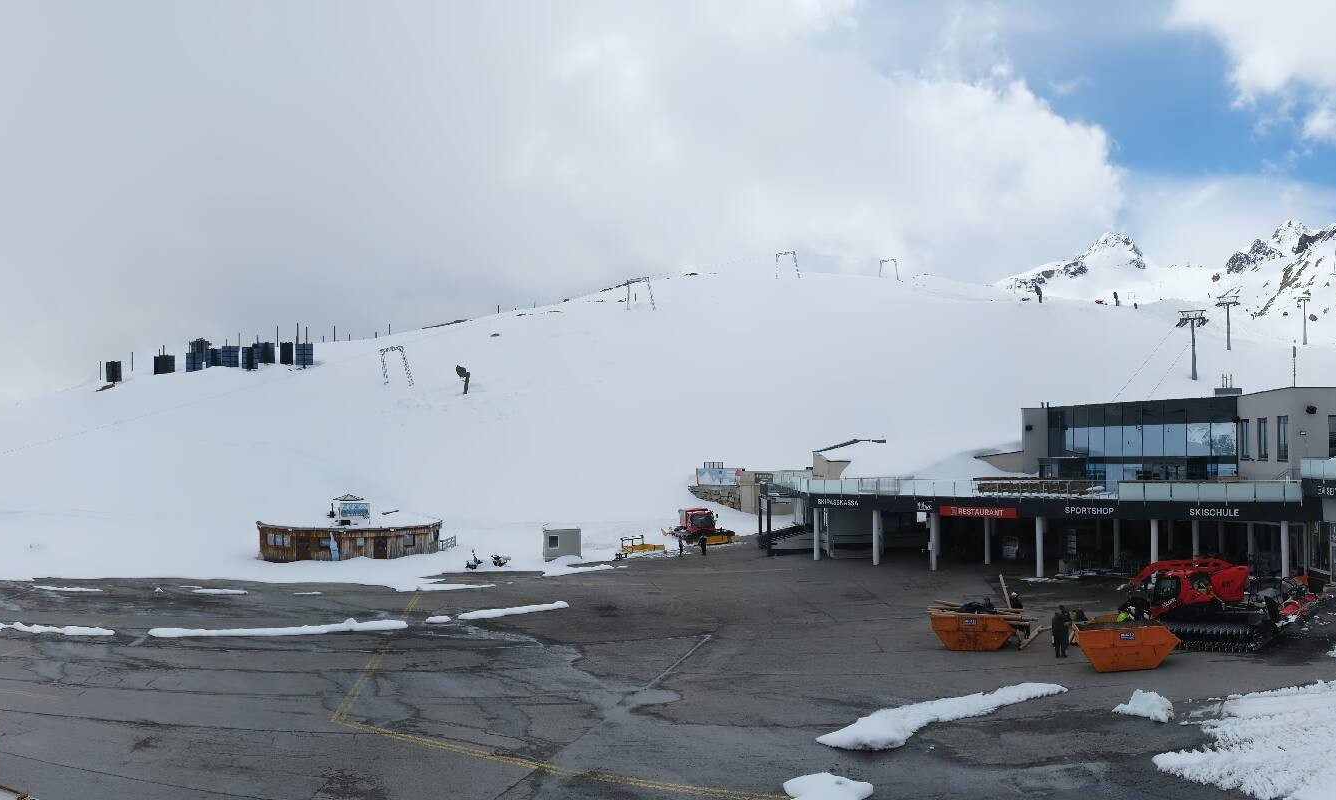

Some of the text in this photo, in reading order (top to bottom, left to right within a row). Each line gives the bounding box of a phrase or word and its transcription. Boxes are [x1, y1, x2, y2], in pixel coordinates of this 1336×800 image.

[817, 498, 859, 506] SKIPASSKASSA
[958, 507, 1004, 517] RESTAURANT
[1065, 506, 1115, 515] SPORTSHOP
[1189, 508, 1240, 517] SKISCHULE
